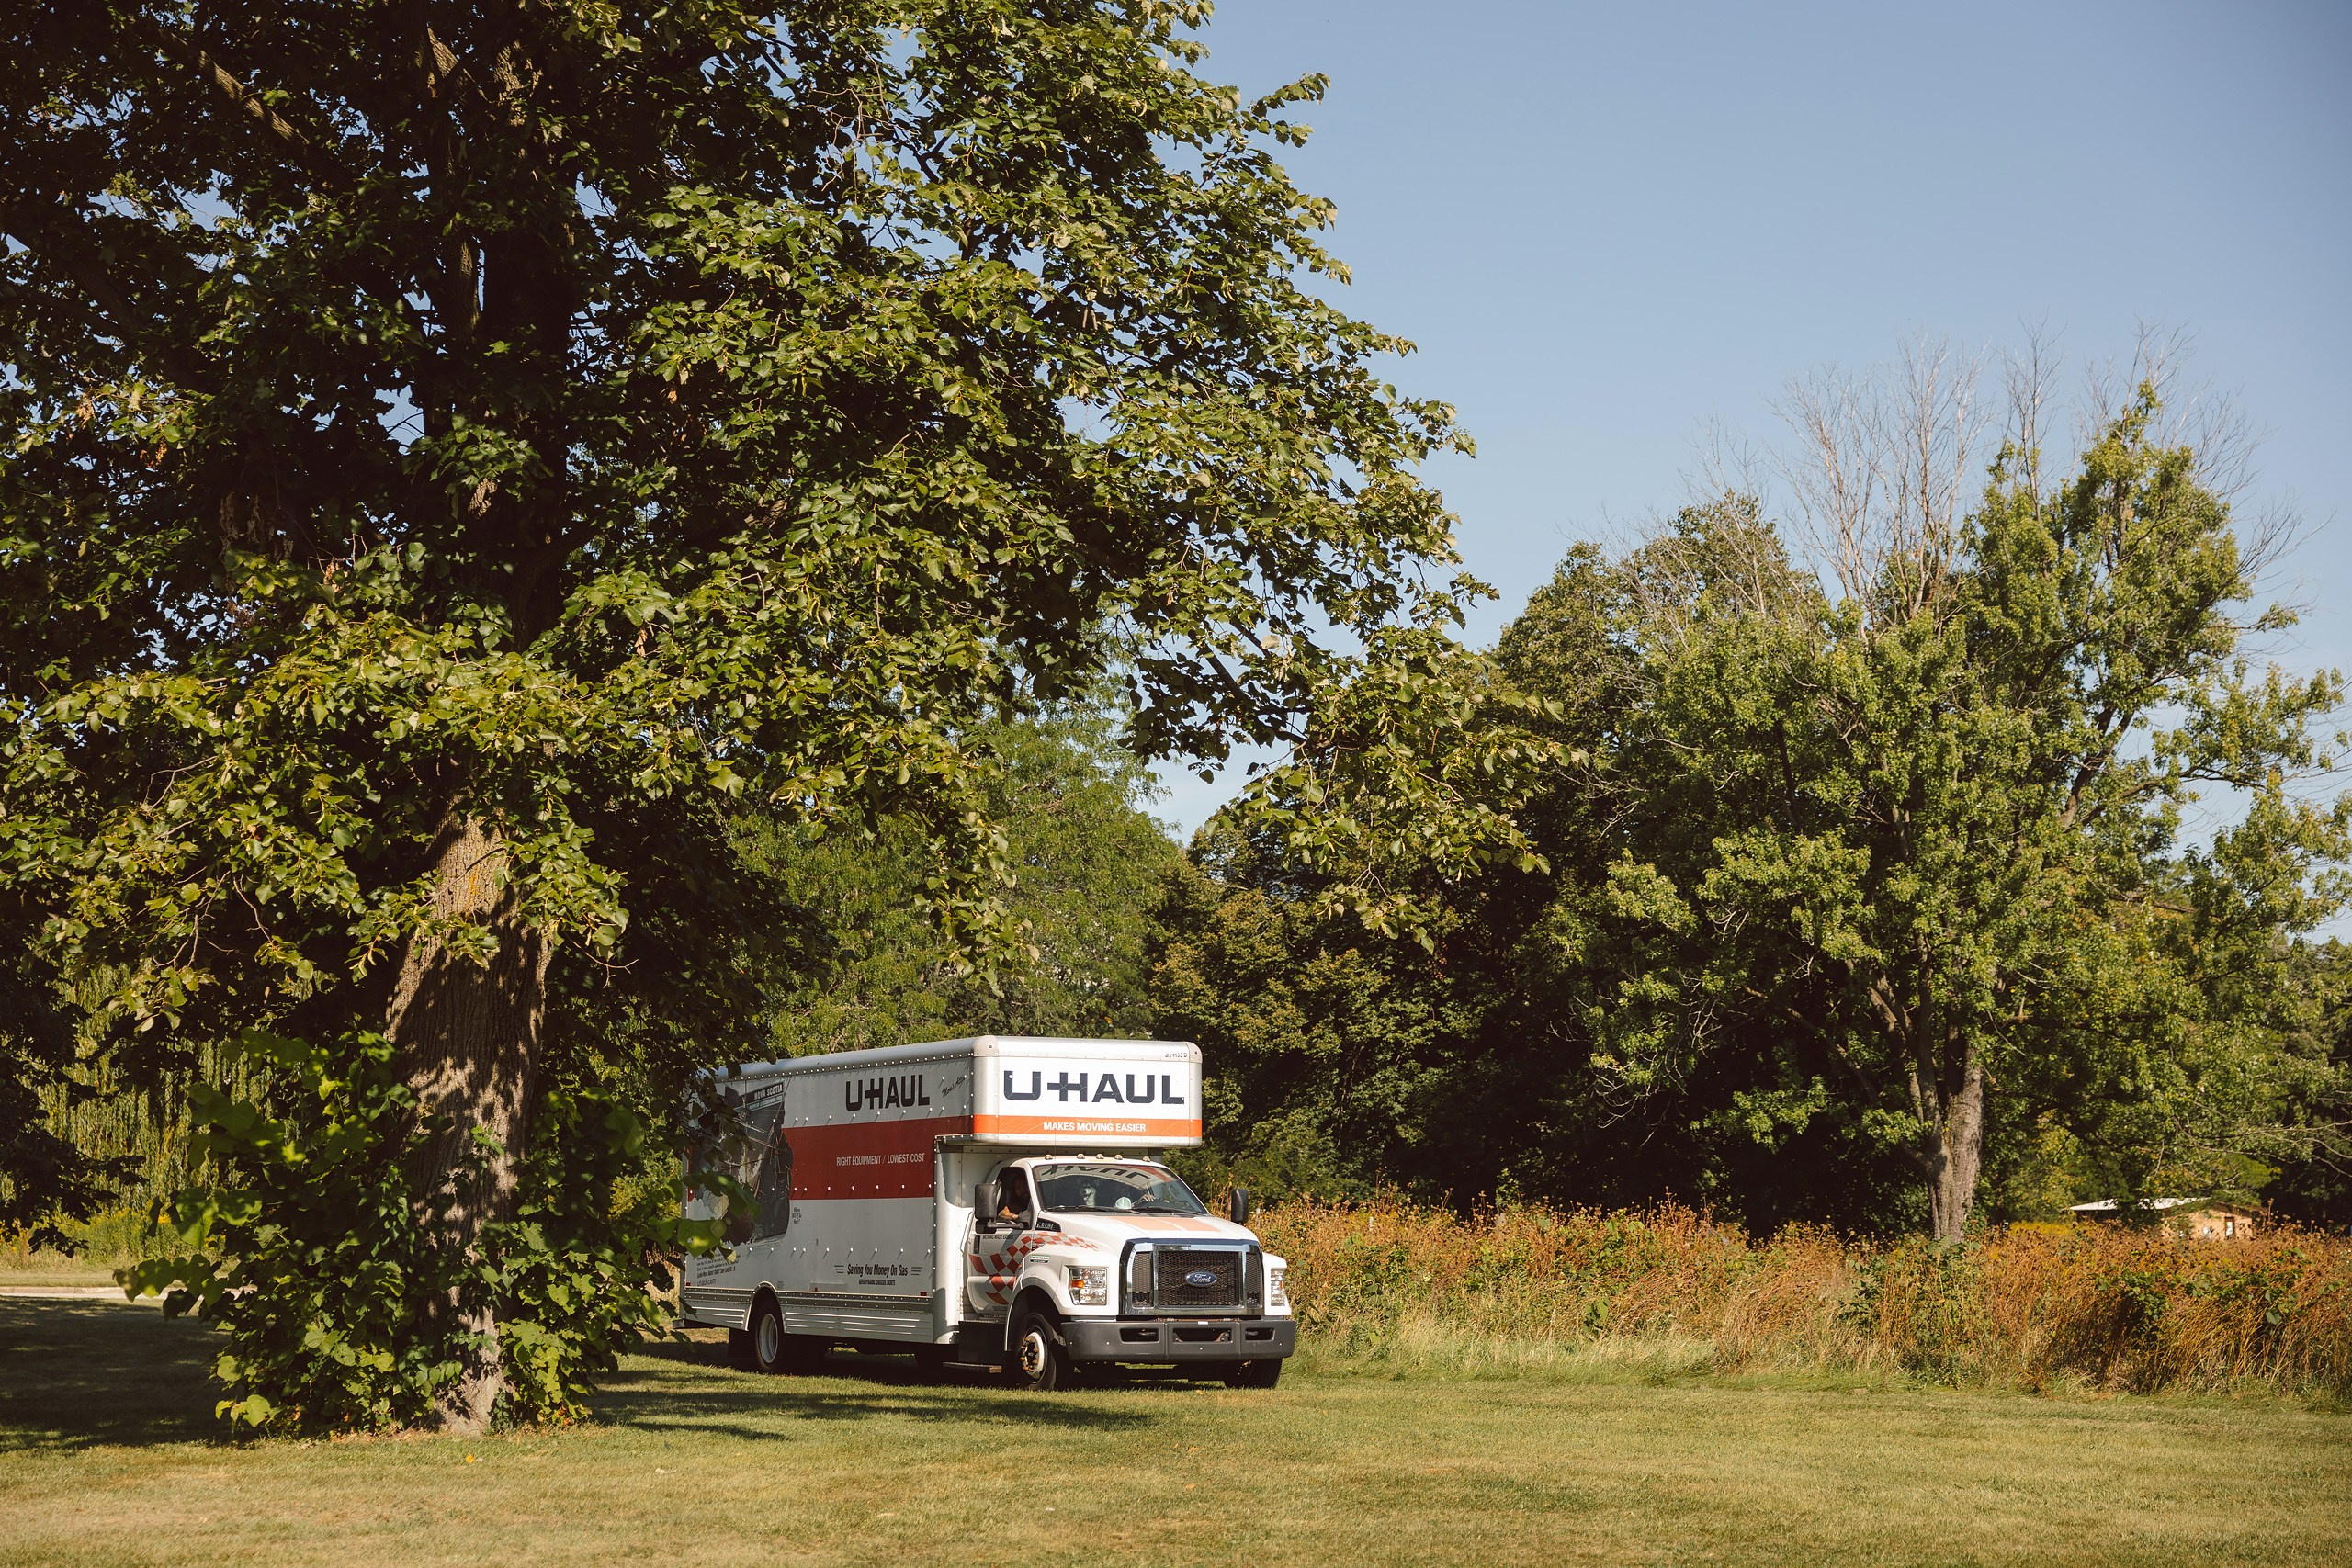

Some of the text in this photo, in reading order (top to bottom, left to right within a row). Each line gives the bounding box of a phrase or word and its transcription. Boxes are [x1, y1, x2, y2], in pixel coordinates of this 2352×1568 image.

[766, 1084, 783, 1097] SCOTIA
[845, 1074, 931, 1111] U-HAUL
[1003, 1070, 1185, 1105] U-HAUL
[1043, 1122, 1147, 1133] MAKES MOVING EASIER
[836, 1156, 852, 1167] RIGHT
[852, 1155, 882, 1167] EQUIPMENT
[887, 1154, 910, 1164] LOWEST
[910, 1153, 926, 1163] COST
[847, 1263, 909, 1278] Saving You Money On Gas
[1193, 1273, 1211, 1283] Ford
